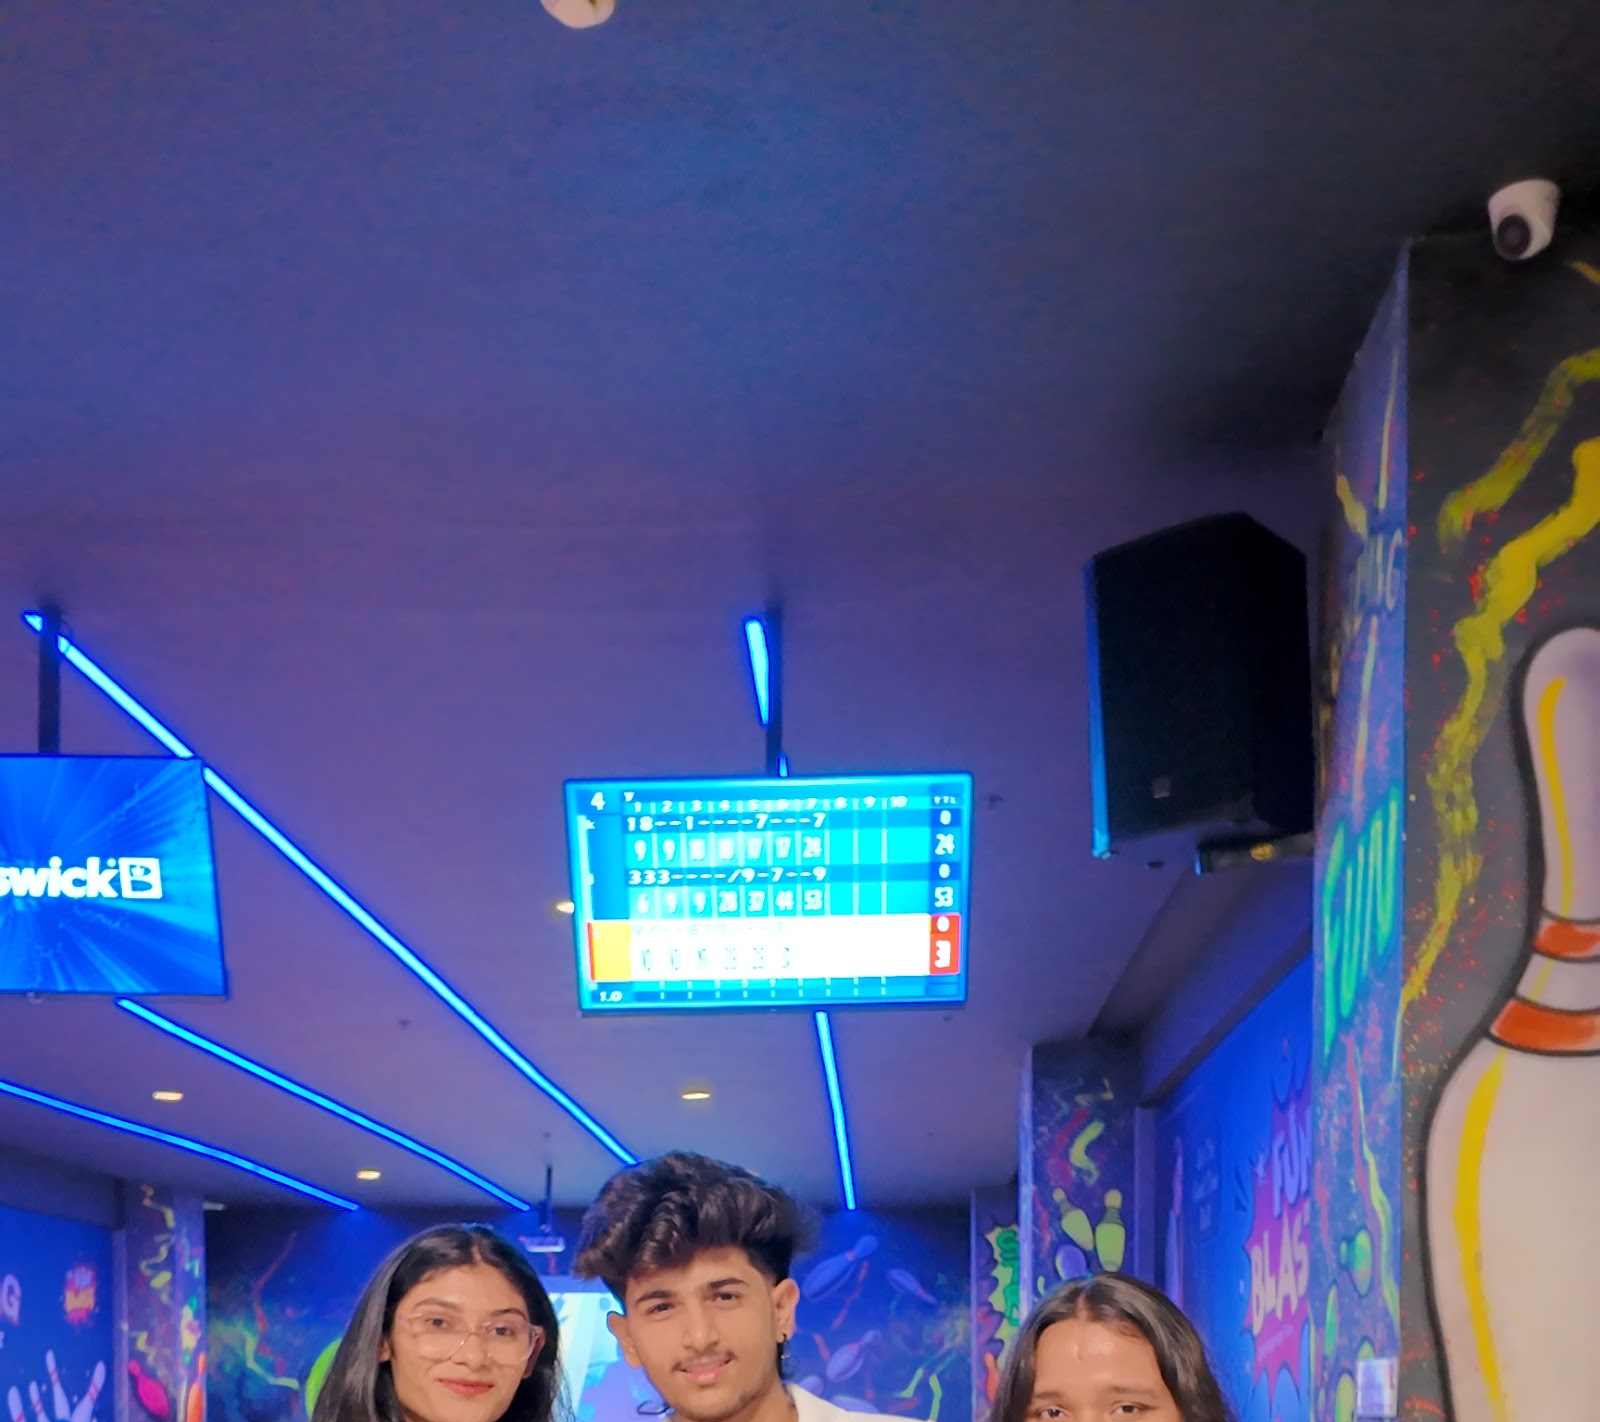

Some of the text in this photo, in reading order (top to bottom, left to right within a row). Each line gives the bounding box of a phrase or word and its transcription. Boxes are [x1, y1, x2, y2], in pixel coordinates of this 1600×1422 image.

[590, 791, 606, 811] 4
[934, 833, 955, 855] 24
[934, 886, 954, 908] 53
